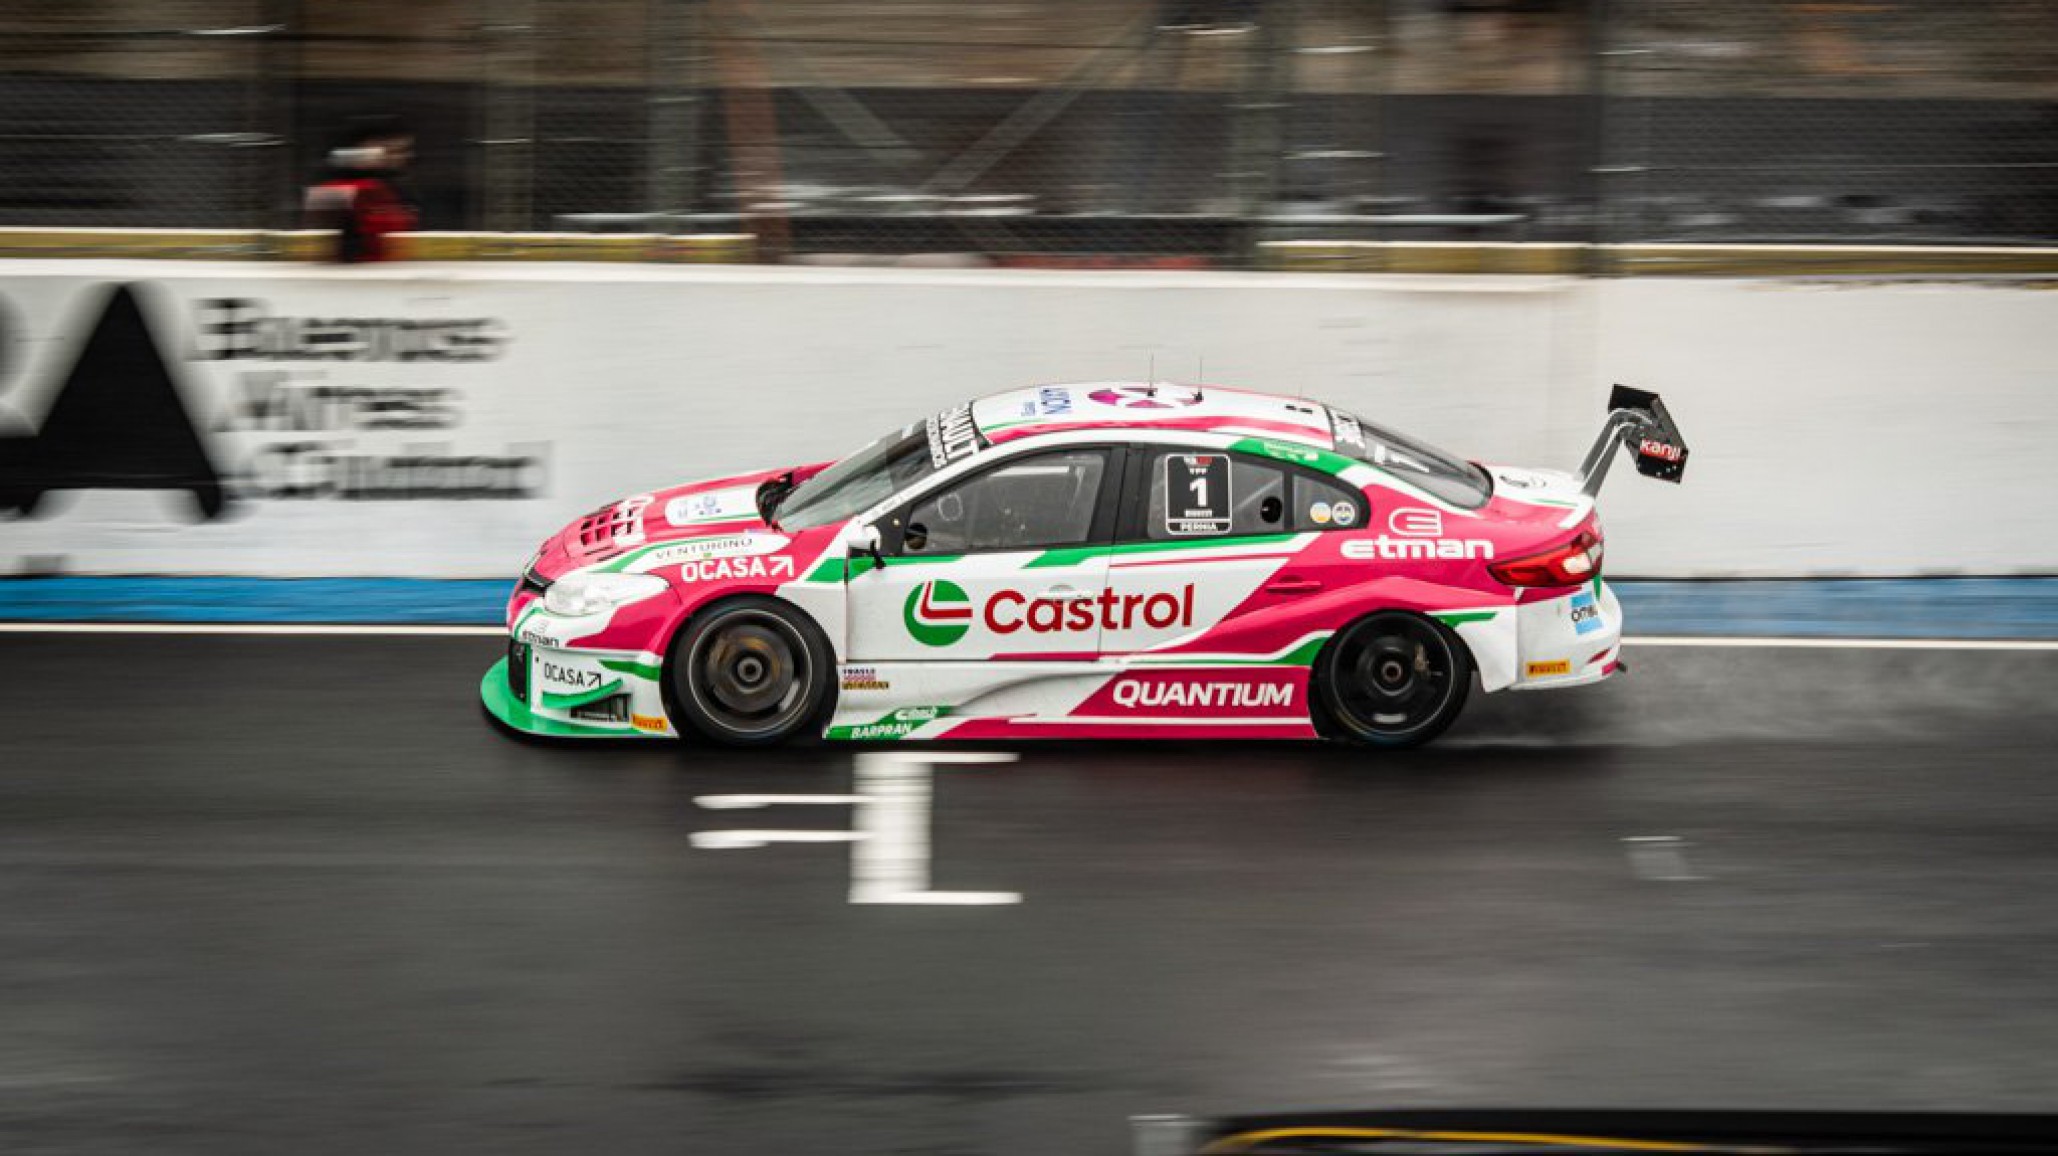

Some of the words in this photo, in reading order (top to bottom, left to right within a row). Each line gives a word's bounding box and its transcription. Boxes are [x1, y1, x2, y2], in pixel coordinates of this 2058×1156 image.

[1190, 478, 1207, 507] 1
[1340, 535, 1494, 560] etman
[680, 556, 767, 583] OCASA
[984, 583, 1195, 634] Castrol
[544, 662, 586, 687] OCASA
[1112, 679, 1294, 707] QUANTIUM
